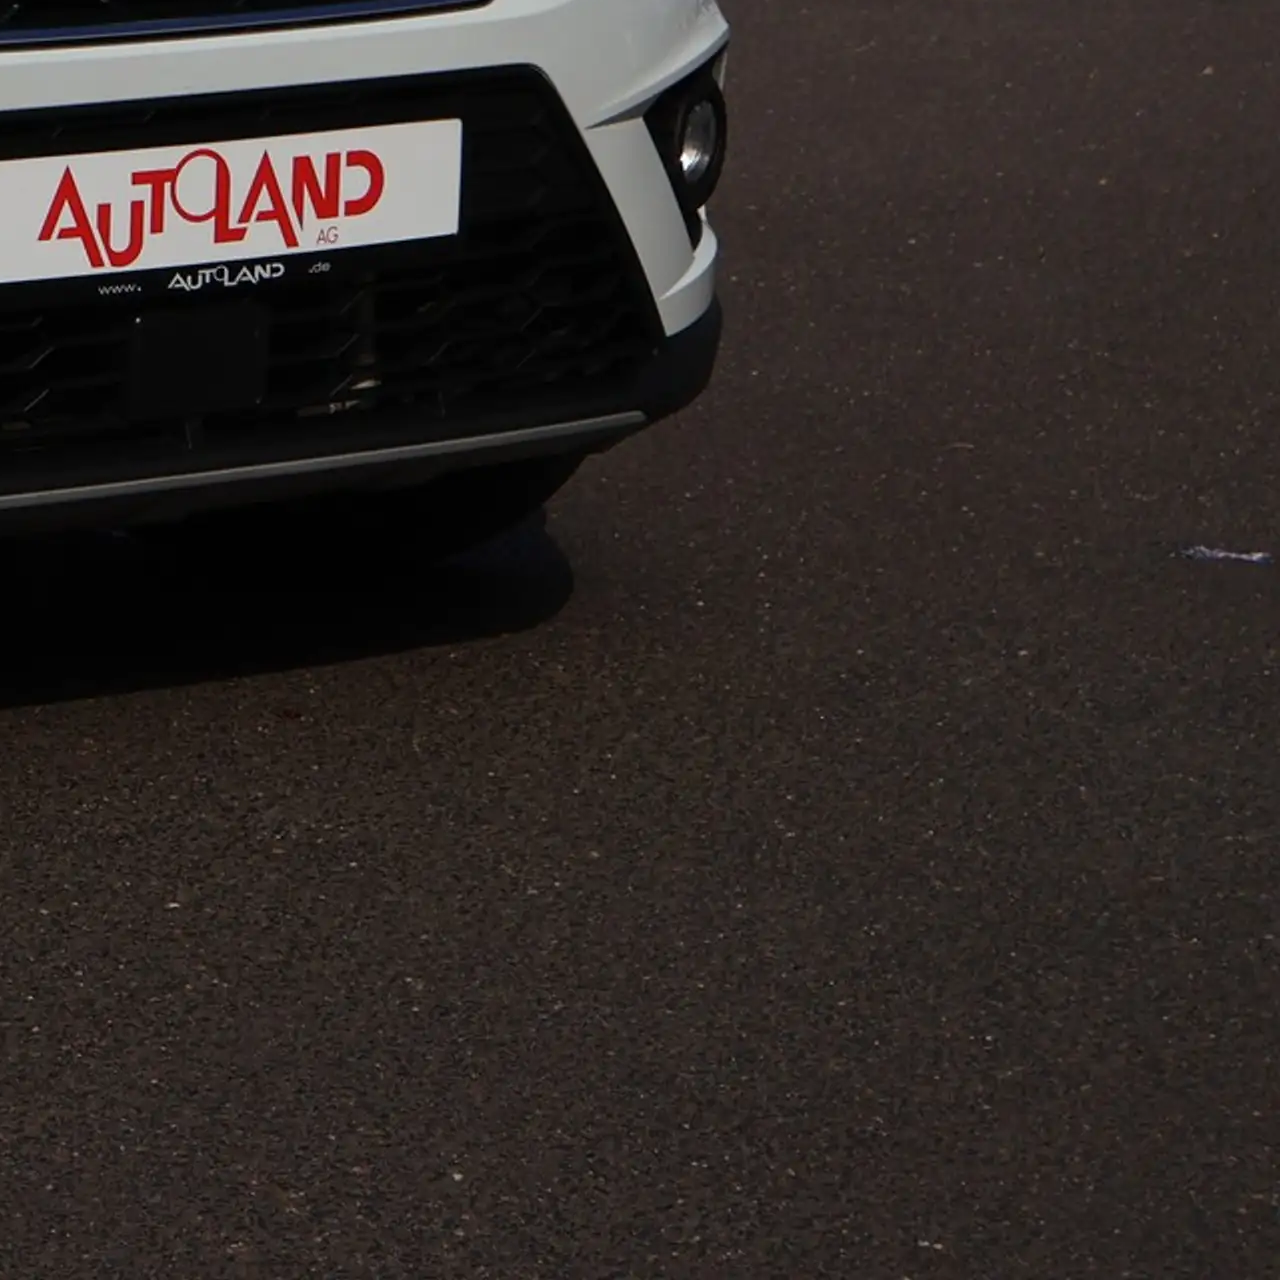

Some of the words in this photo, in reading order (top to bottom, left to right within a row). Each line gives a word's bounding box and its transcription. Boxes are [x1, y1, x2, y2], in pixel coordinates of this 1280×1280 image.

[38, 148, 385, 269] AUTOLAND
[317, 227, 339, 245] AG
[168, 265, 285, 292] AUTOLAND
